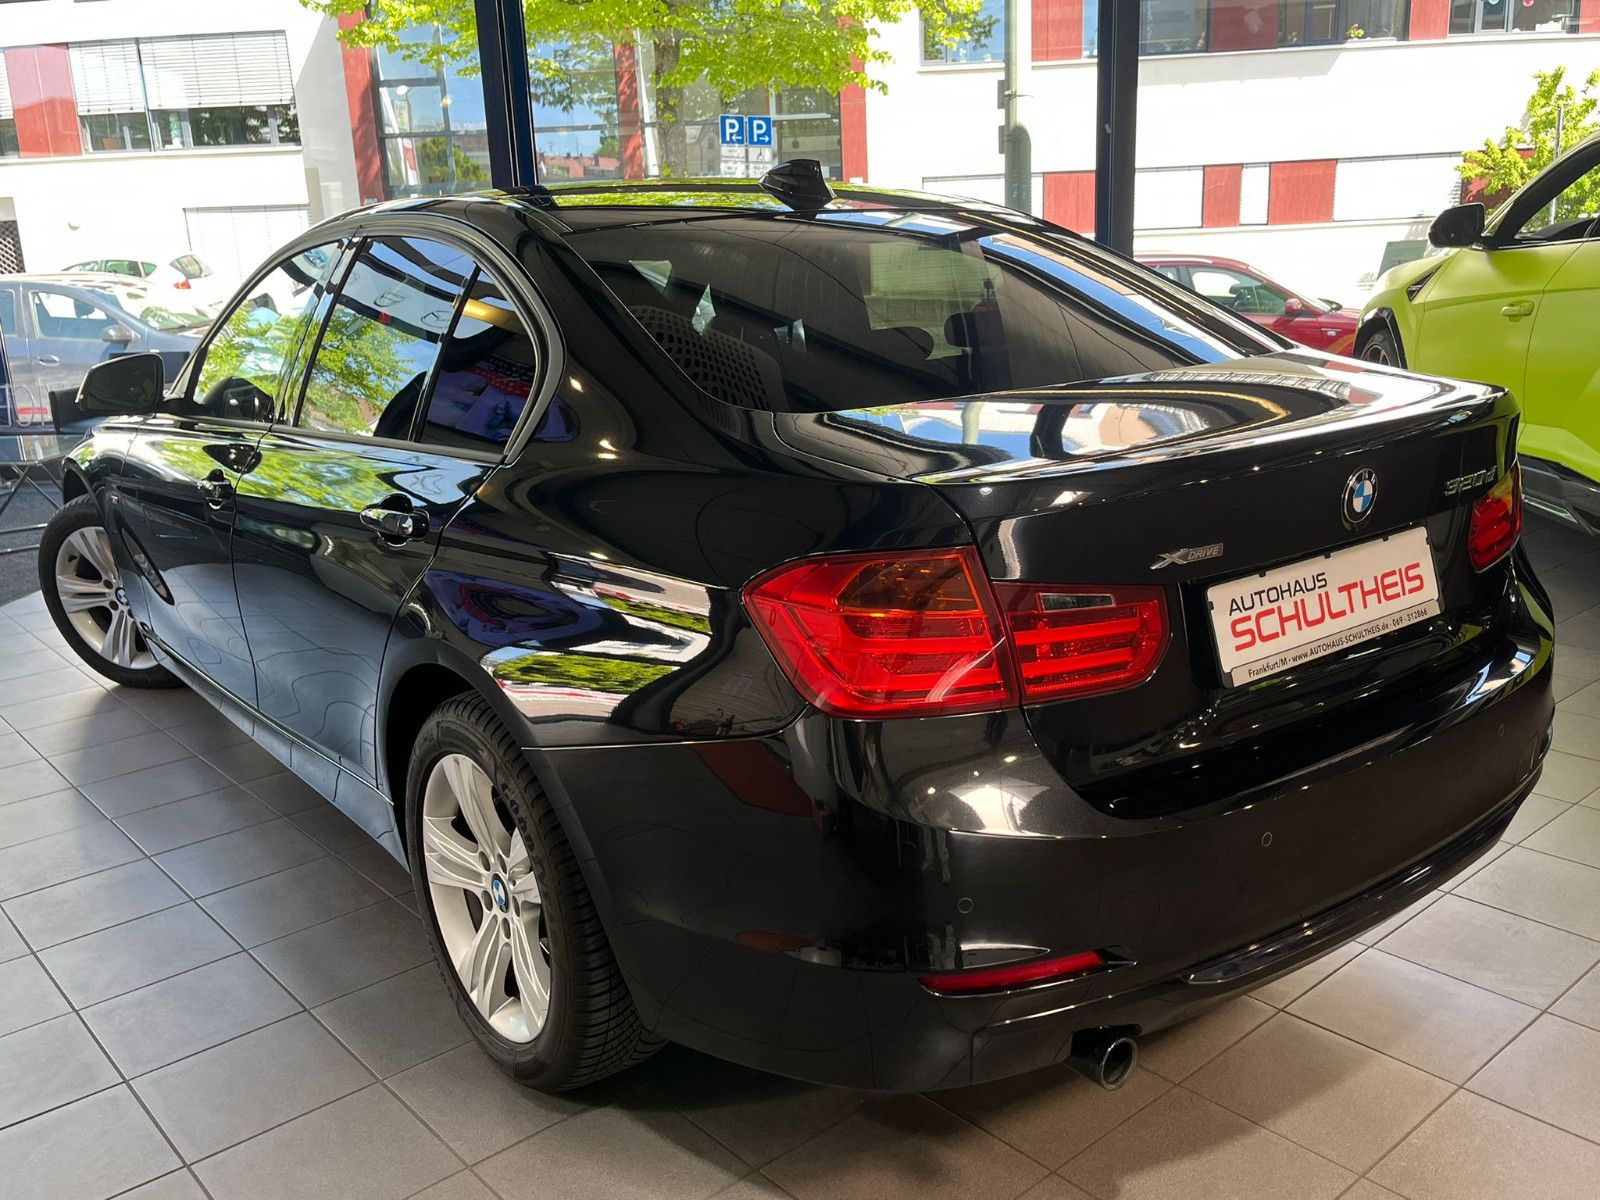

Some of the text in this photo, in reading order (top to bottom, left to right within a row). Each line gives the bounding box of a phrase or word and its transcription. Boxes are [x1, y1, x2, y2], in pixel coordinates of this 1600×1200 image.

[725, 119, 739, 141] P
[753, 120, 767, 142] P
[1229, 572, 1328, 616] AUTOHAUS
[1230, 562, 1425, 652] SCHULTHEIS
[1248, 654, 1288, 678] Frankfurt/M
[1392, 617, 1404, 628] 069
